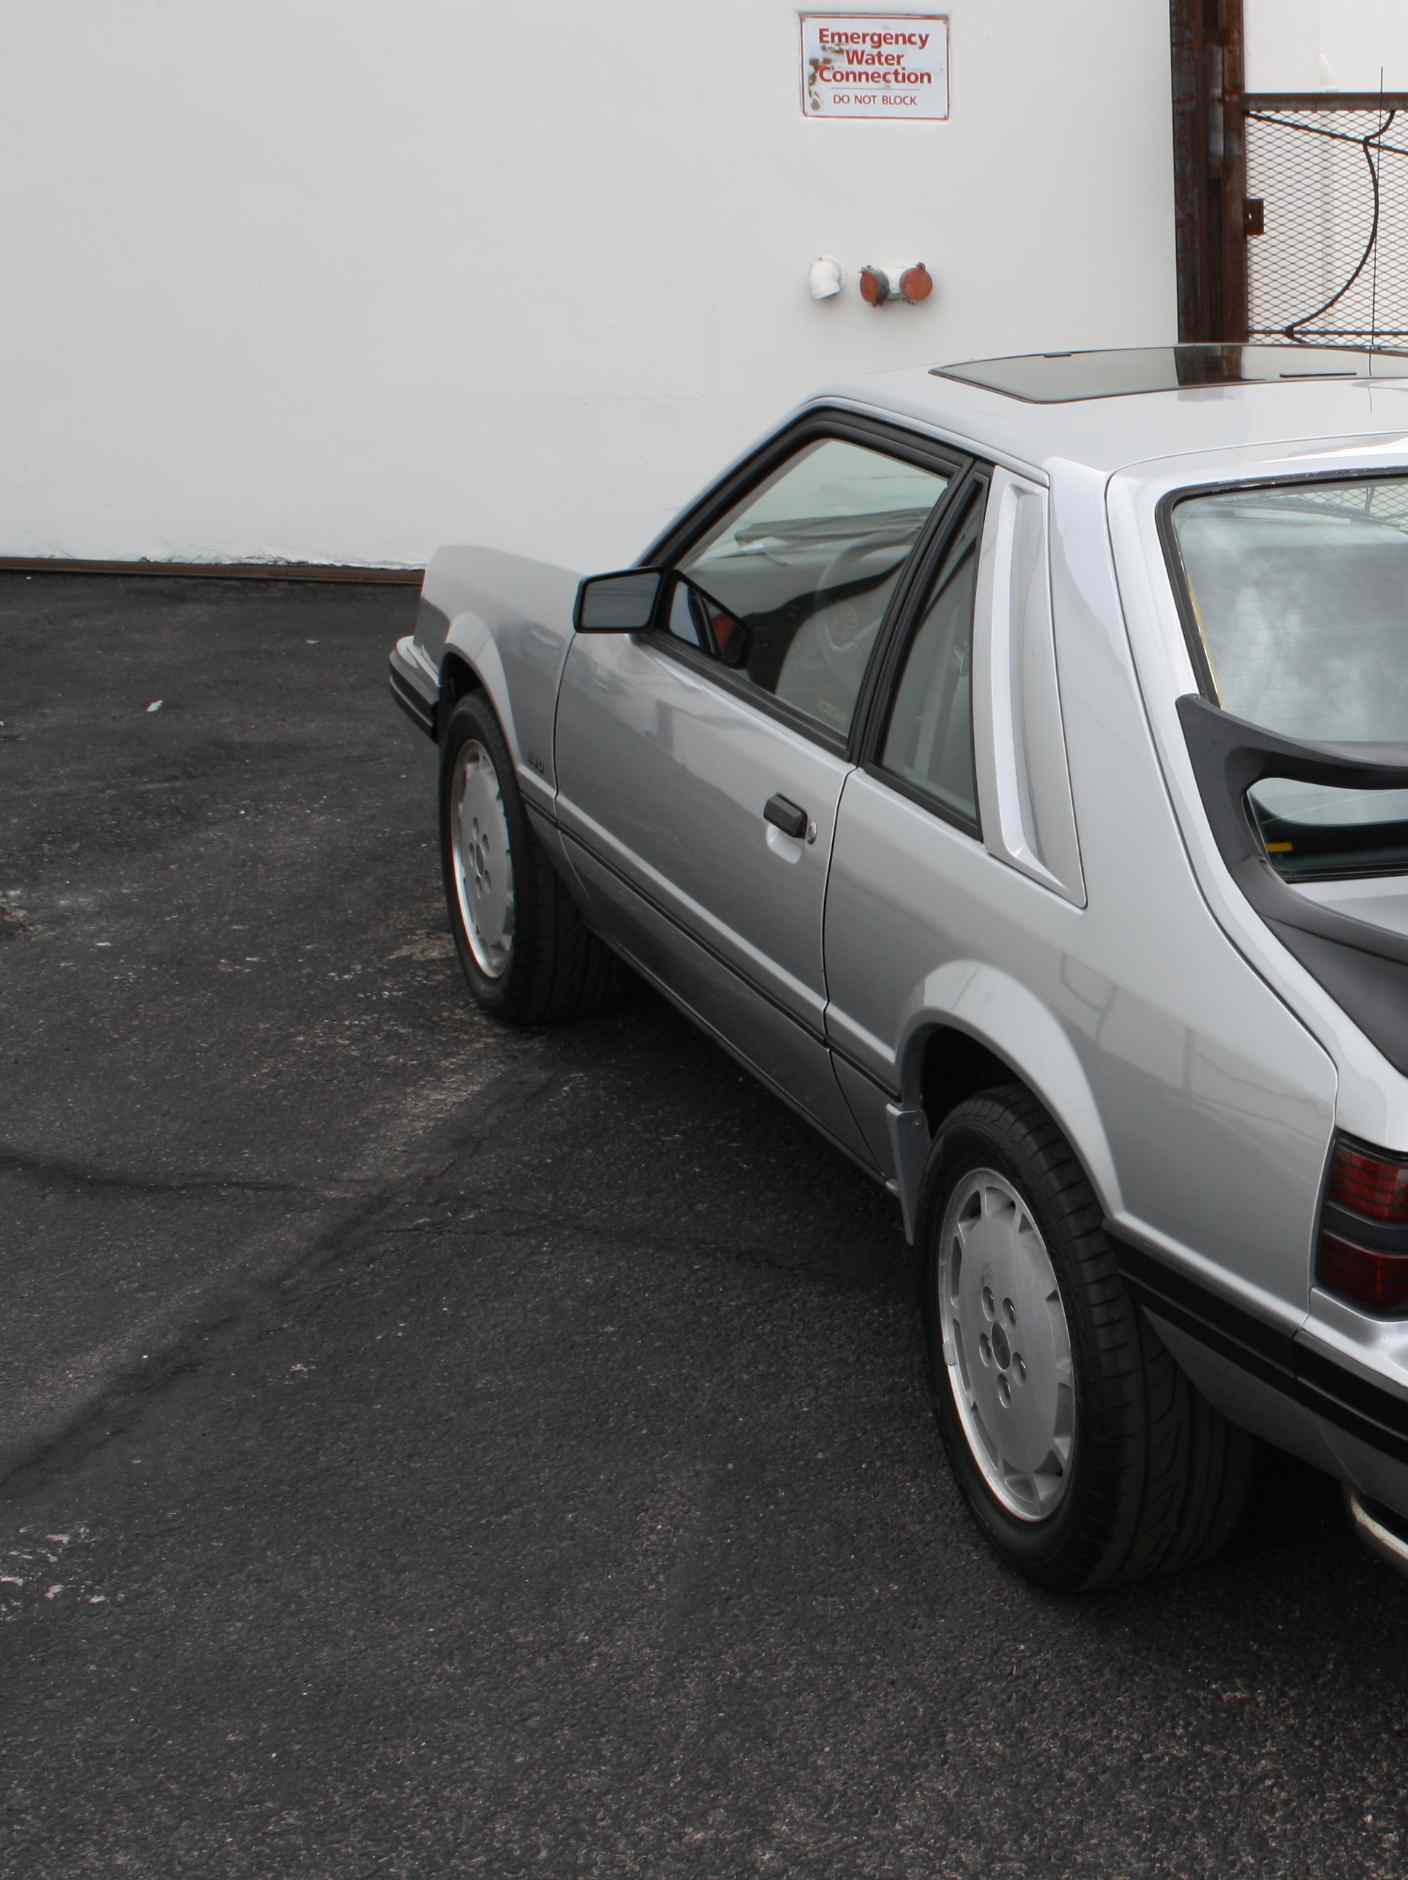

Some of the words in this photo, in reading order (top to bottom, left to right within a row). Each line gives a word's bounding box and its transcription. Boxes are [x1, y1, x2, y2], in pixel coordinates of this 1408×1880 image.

[818, 28, 930, 49] Emergency
[846, 50, 905, 66] Water
[817, 66, 932, 84] Connection
[833, 94, 850, 105] DO
[854, 95, 878, 105] NOT
[882, 95, 918, 106] BLOCK
